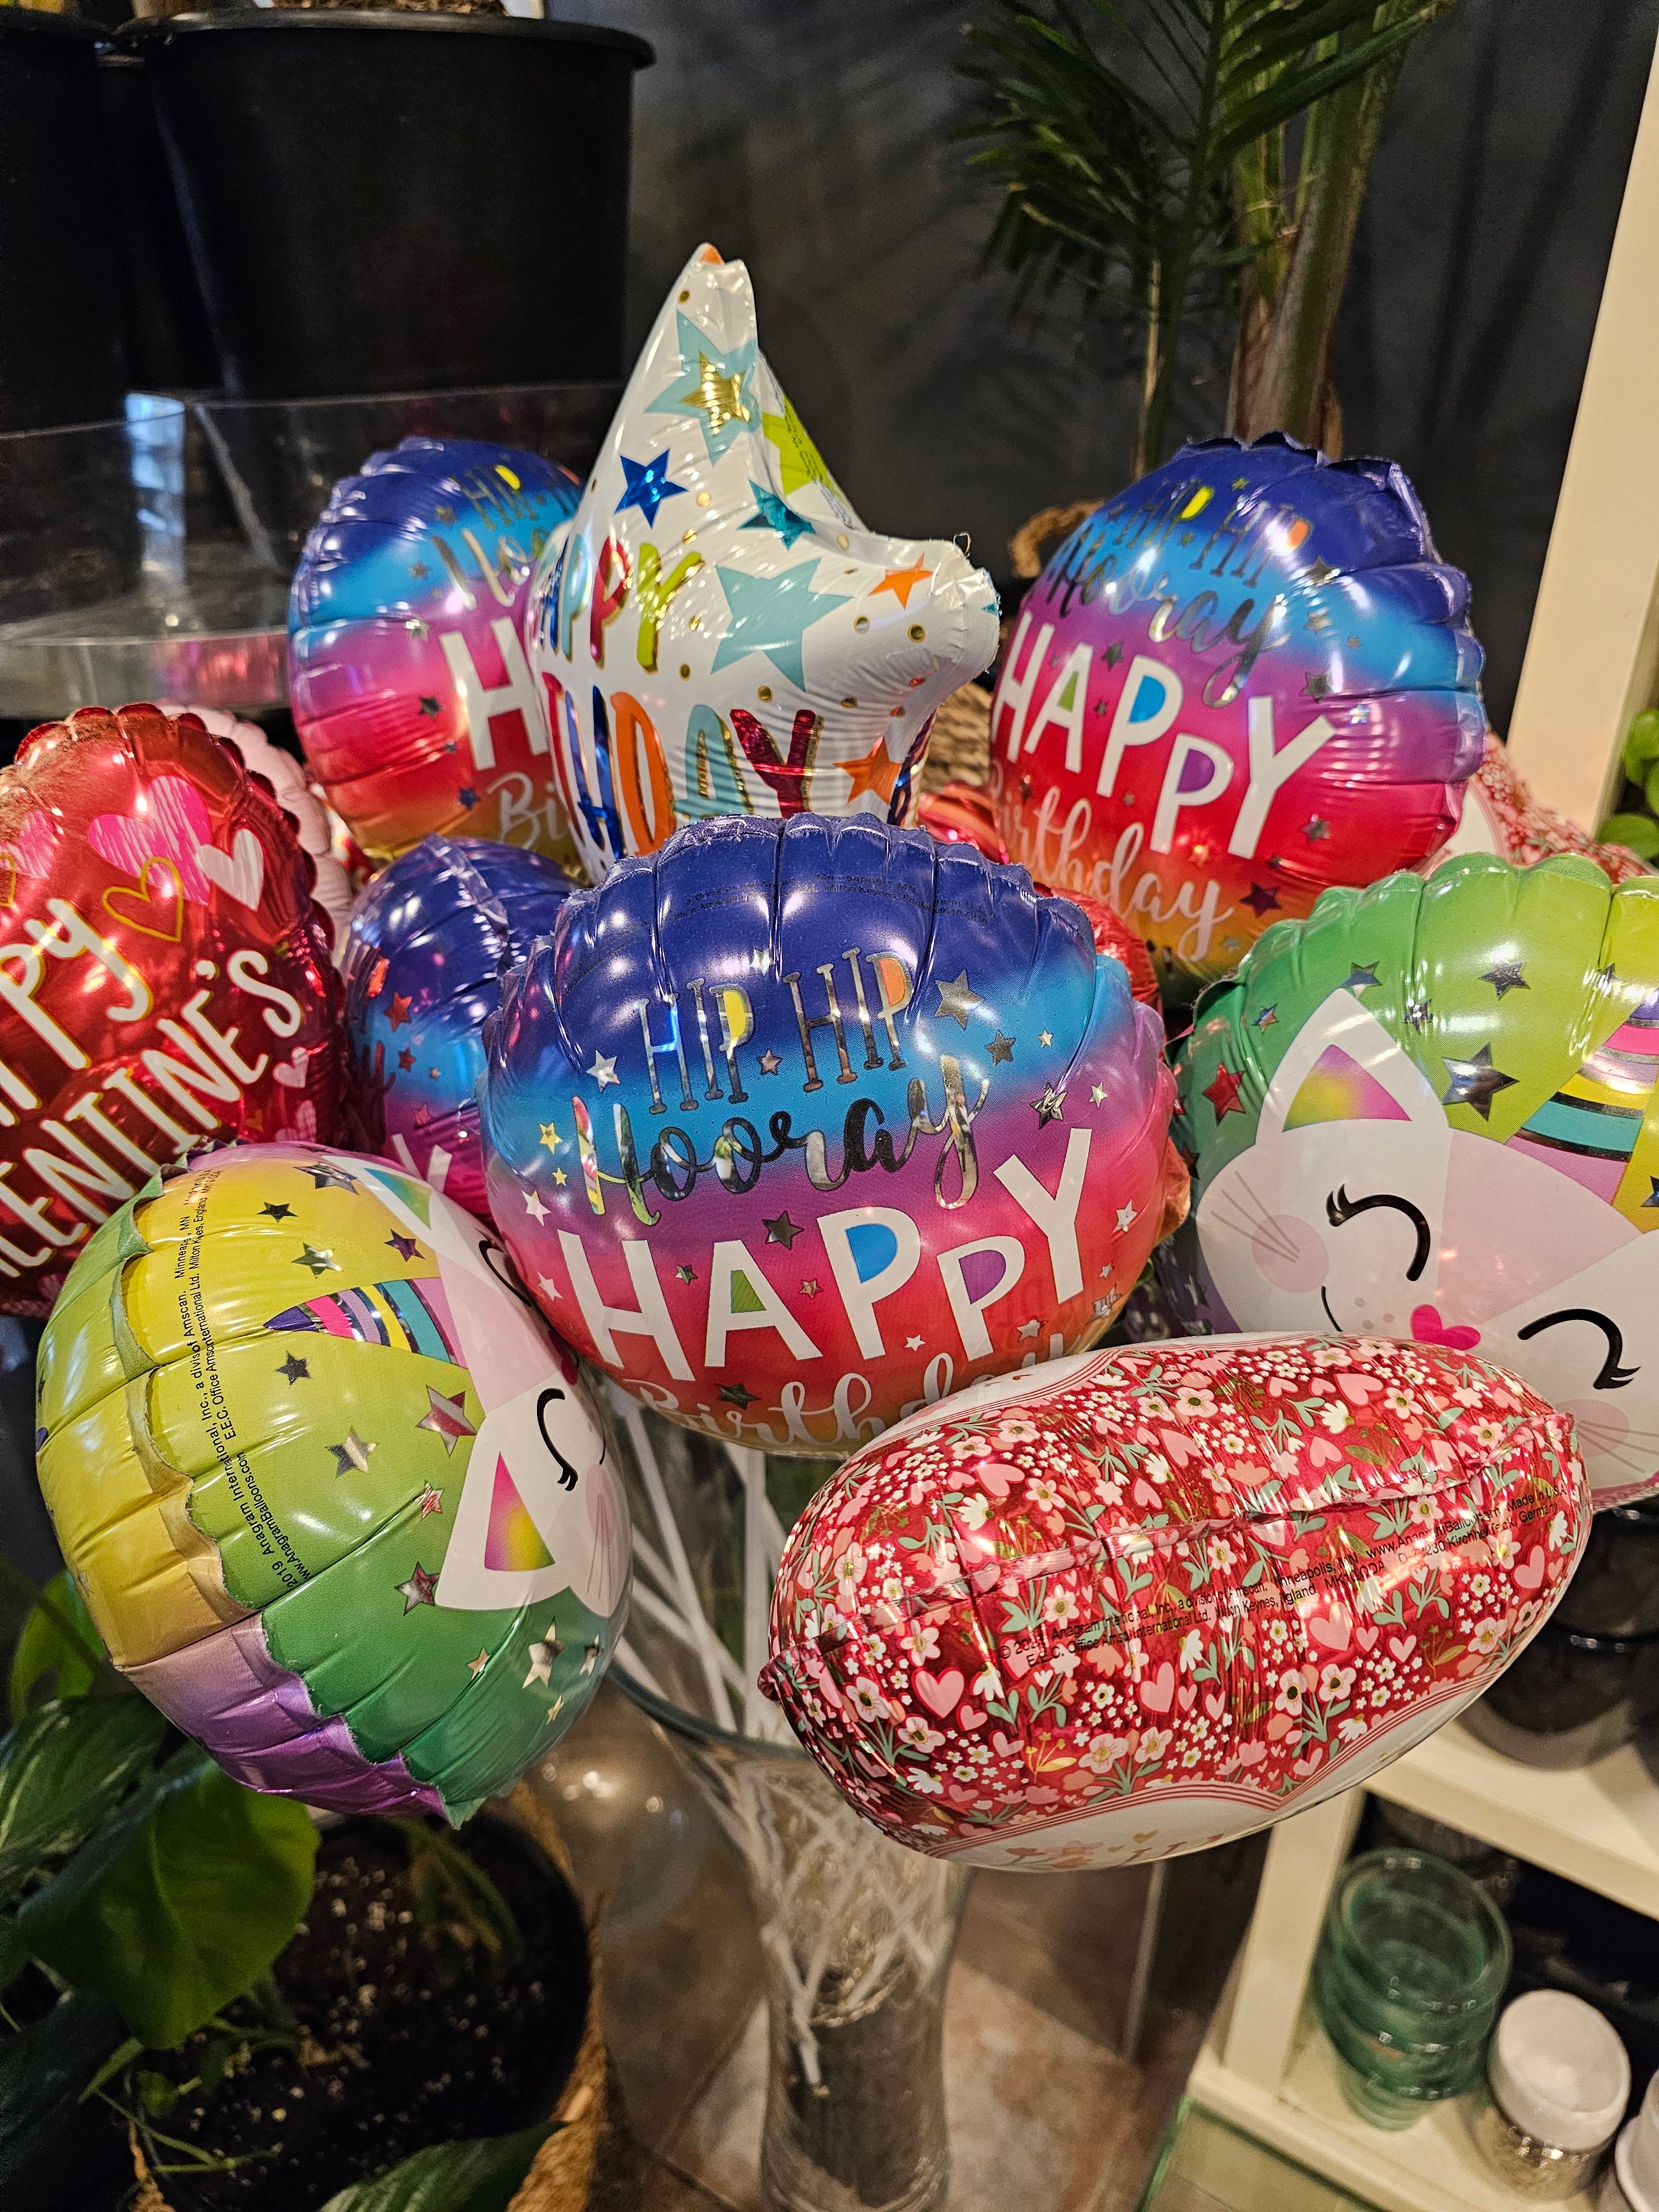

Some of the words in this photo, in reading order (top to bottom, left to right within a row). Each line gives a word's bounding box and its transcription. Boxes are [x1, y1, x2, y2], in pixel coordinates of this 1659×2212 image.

[994, 611, 1335, 860] HAPPY
[634, 977, 755, 1115] HIP
[783, 947, 914, 1093] HIP
[0, 950, 302, 1277] ENTINE'S
[571, 1055, 990, 1226] Hooray
[180, 1216, 190, 1231] MN
[194, 1198, 207, 1223] England
[189, 1245, 200, 1270] Milton
[557, 1128, 1092, 1381] HAPPY
[189, 1273, 200, 1290] Ltd.
[179, 1290, 195, 1337] Amscan.
[196, 1381, 205, 1390] a
[210, 1374, 224, 1405] Office
[217, 1406, 236, 1440] E.E.C.
[1507, 1492, 1535, 1511] Made
[1519, 1502, 1558, 1524] Germany
[240, 1502, 275, 1555] Anagram
[272, 1561, 299, 1587] 2019
